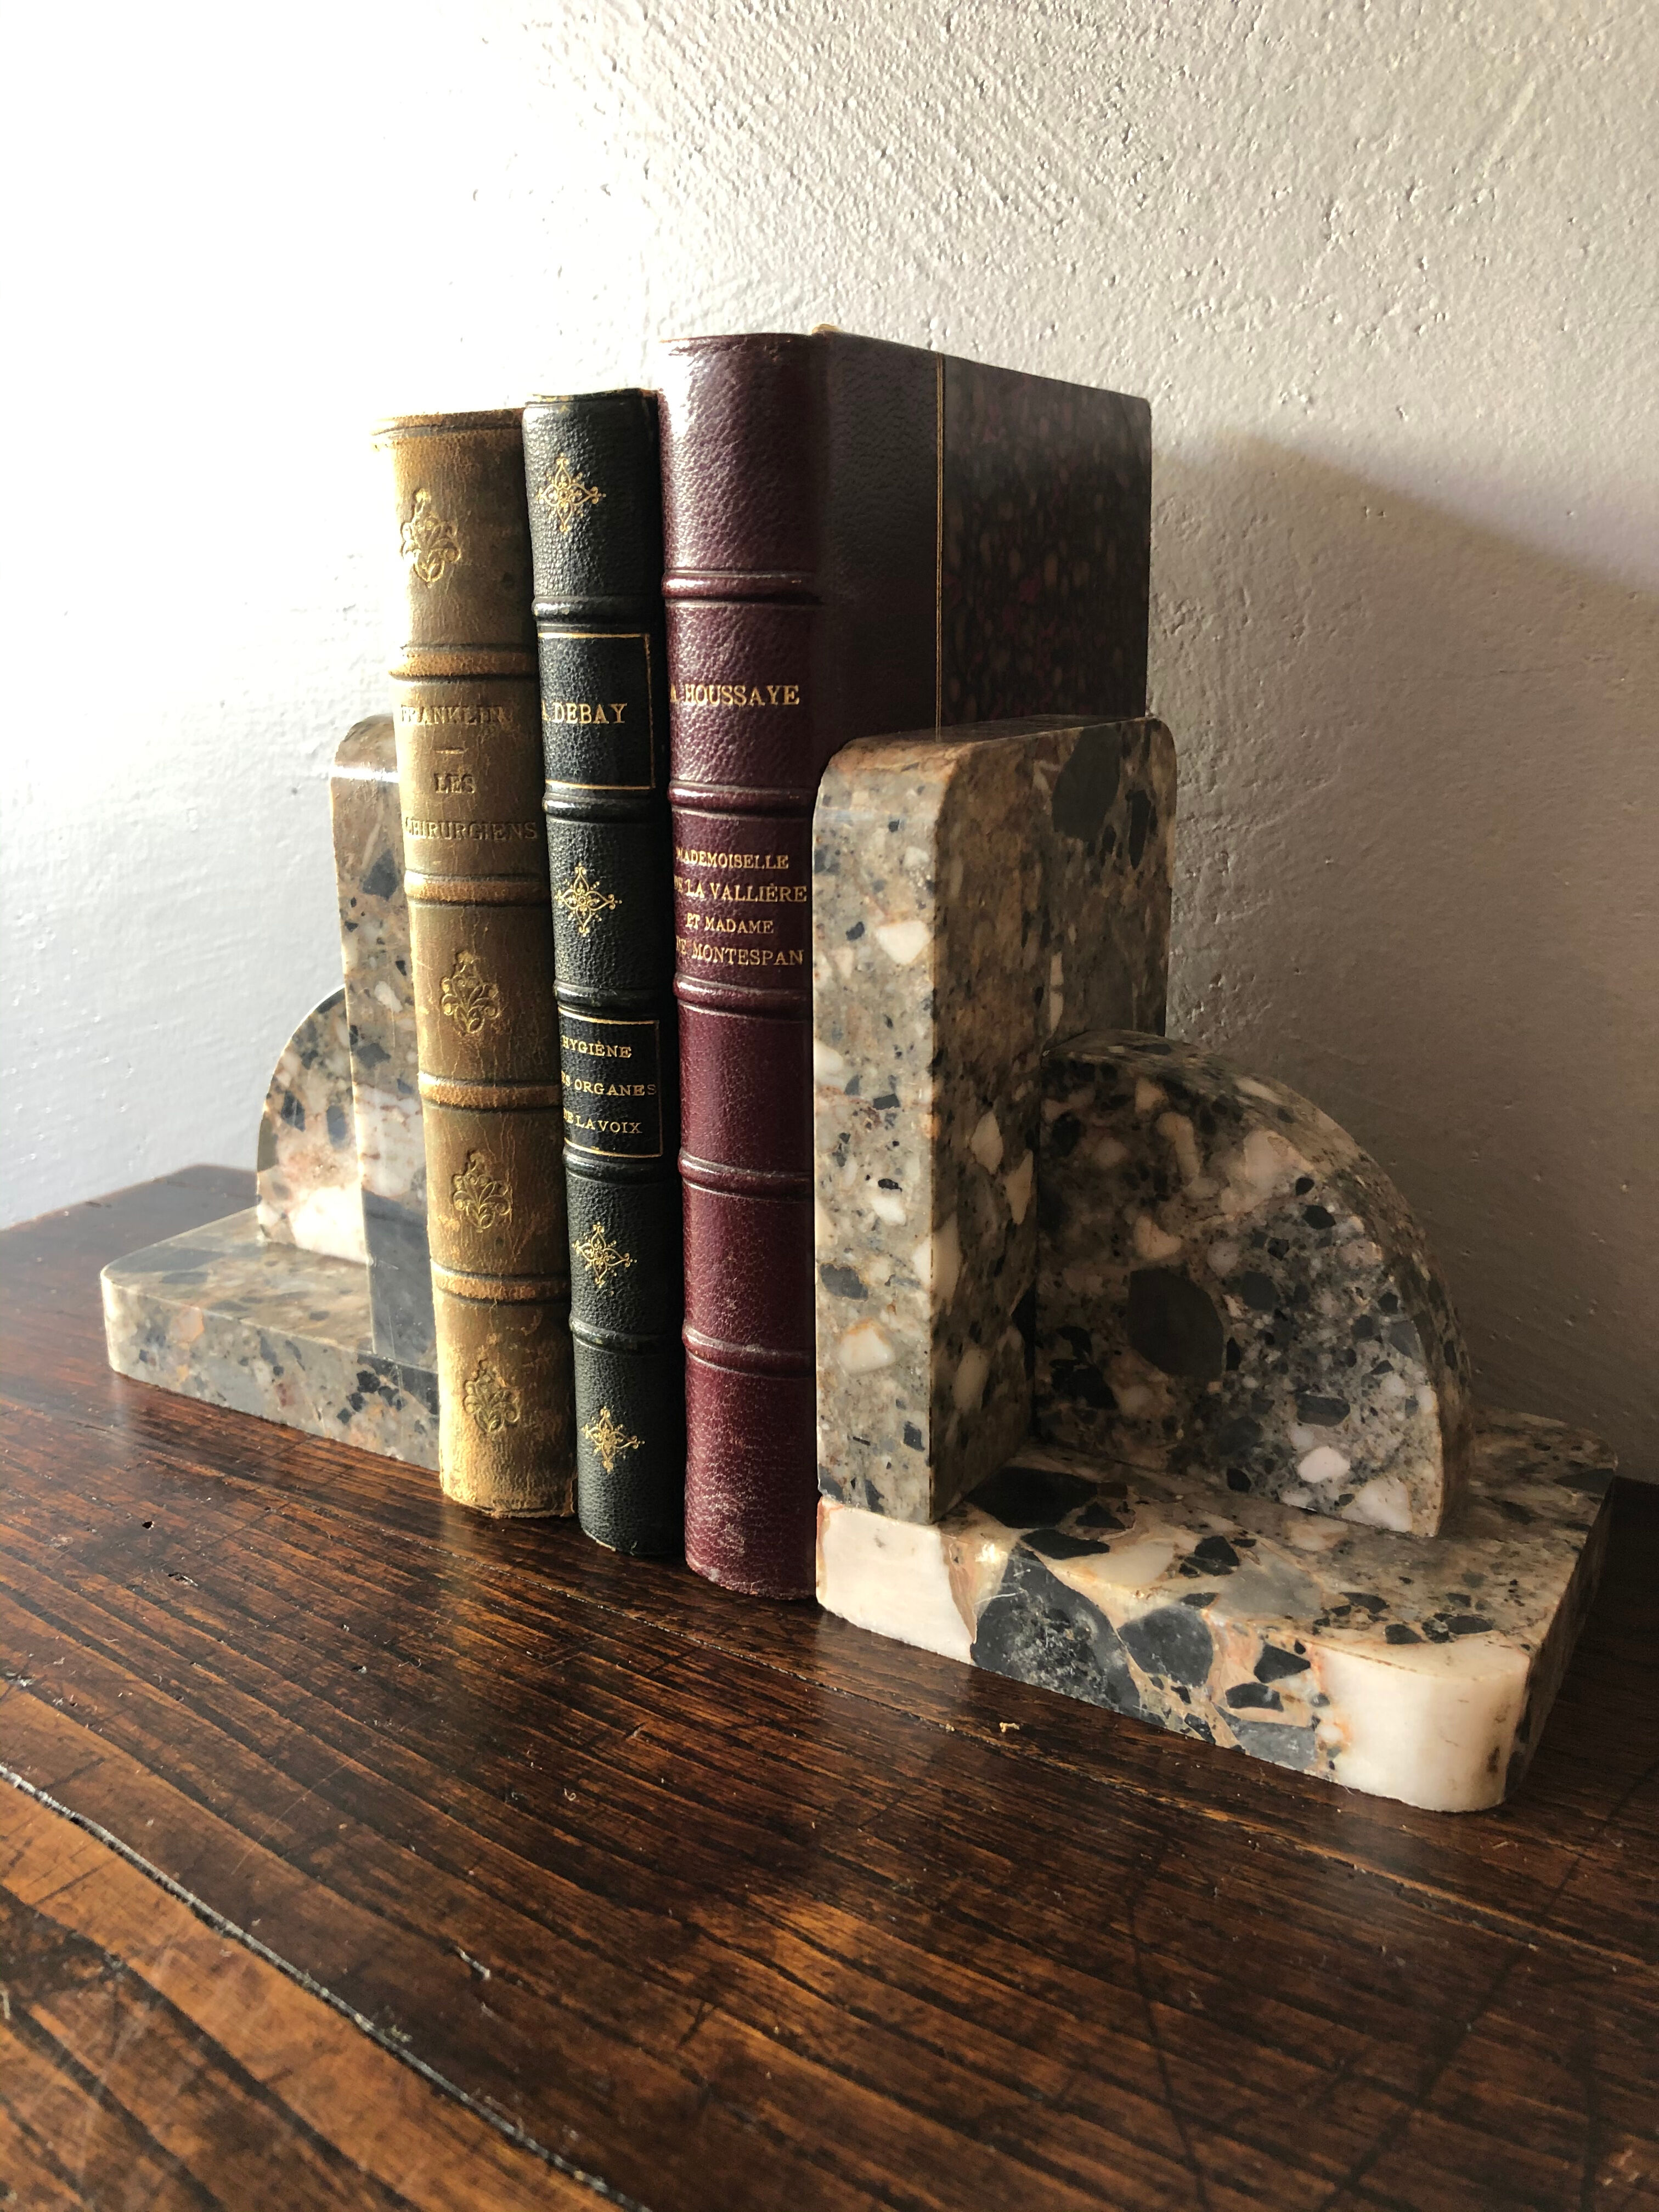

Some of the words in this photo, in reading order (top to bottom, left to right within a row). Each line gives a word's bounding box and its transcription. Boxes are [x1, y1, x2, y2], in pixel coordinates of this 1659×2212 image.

[684, 684, 800, 707] HOUSSAYE
[552, 702, 628, 724] DEBAY
[433, 772, 476, 794] LES
[675, 847, 789, 870] MADEMOISELLE
[685, 879, 705, 899] LA
[709, 882, 807, 902] VALLIÈRE
[685, 912, 701, 930] ET
[704, 916, 774, 934] MADAME
[691, 941, 804, 966] MONTESPAN
[562, 1035, 632, 1059] HYGIÈNE
[561, 1070, 571, 1087] ES
[574, 1079, 657, 1096] ORGANES
[575, 1115, 595, 1130] LA
[597, 1120, 643, 1134] VOIX
